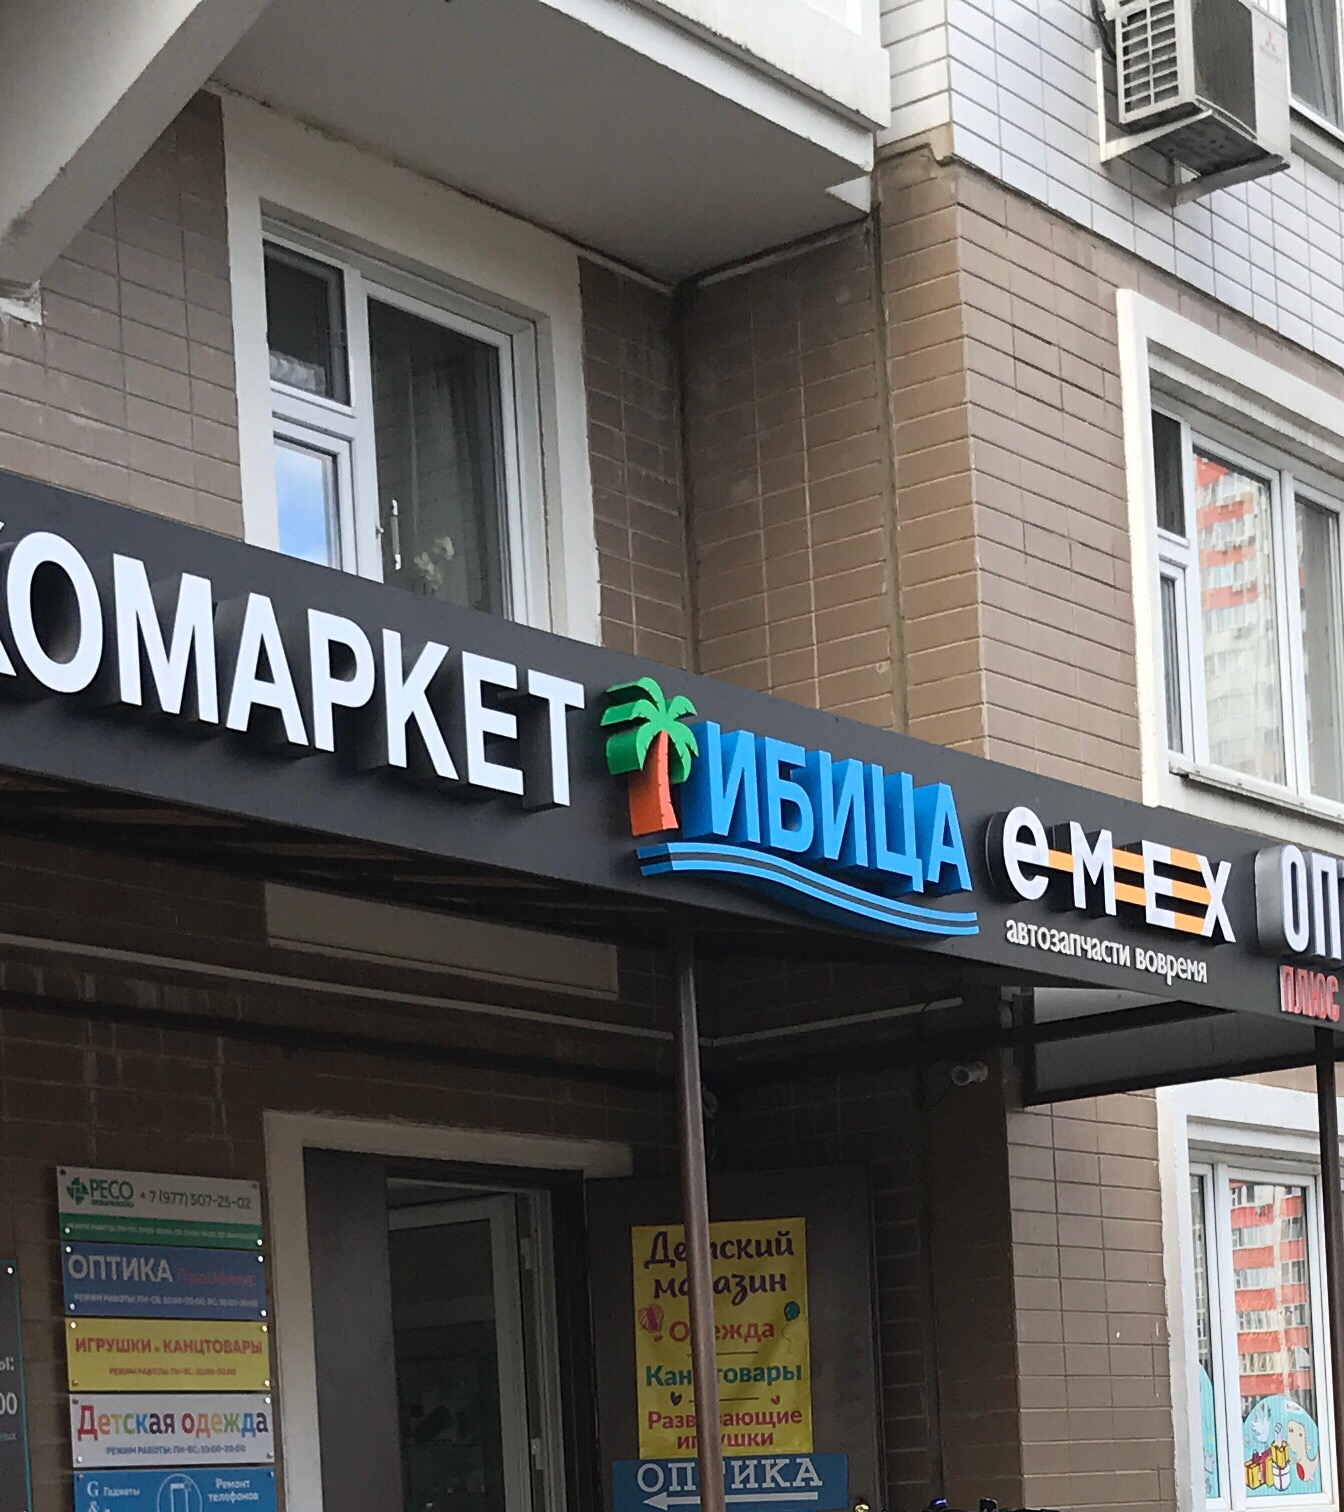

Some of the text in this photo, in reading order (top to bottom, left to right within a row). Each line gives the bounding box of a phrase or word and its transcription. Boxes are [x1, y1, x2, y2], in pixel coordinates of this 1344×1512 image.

[694, 720, 973, 893] ИБИЦА
[1006, 919, 1208, 985] автозапчасти вовремя
[1279, 964, 1341, 1022] ПЛЮС
[89, 1178, 134, 1200] РЕСО
[159, 1189, 188, 1207] (977)
[190, 1193, 253, 1210] 507-25-02
[68, 1255, 173, 1283] ОПТИКА
[653, 1272, 787, 1306] маазин
[668, 1318, 774, 1343] Оежда
[75, 1337, 151, 1353] ИГРУШКИ
[163, 1339, 262, 1356] КАНЦТОВАРЫ
[77, 1404, 269, 1441] Детская одежда
[676, 1432, 774, 1450] игушки
[215, 1478, 250, 1489] Ремонт
[637, 1457, 823, 1492] ОПИКА
[86, 1480, 100, 1497] G
[102, 1486, 141, 1497] Гаджеты
[208, 1492, 259, 1504] телефонов
